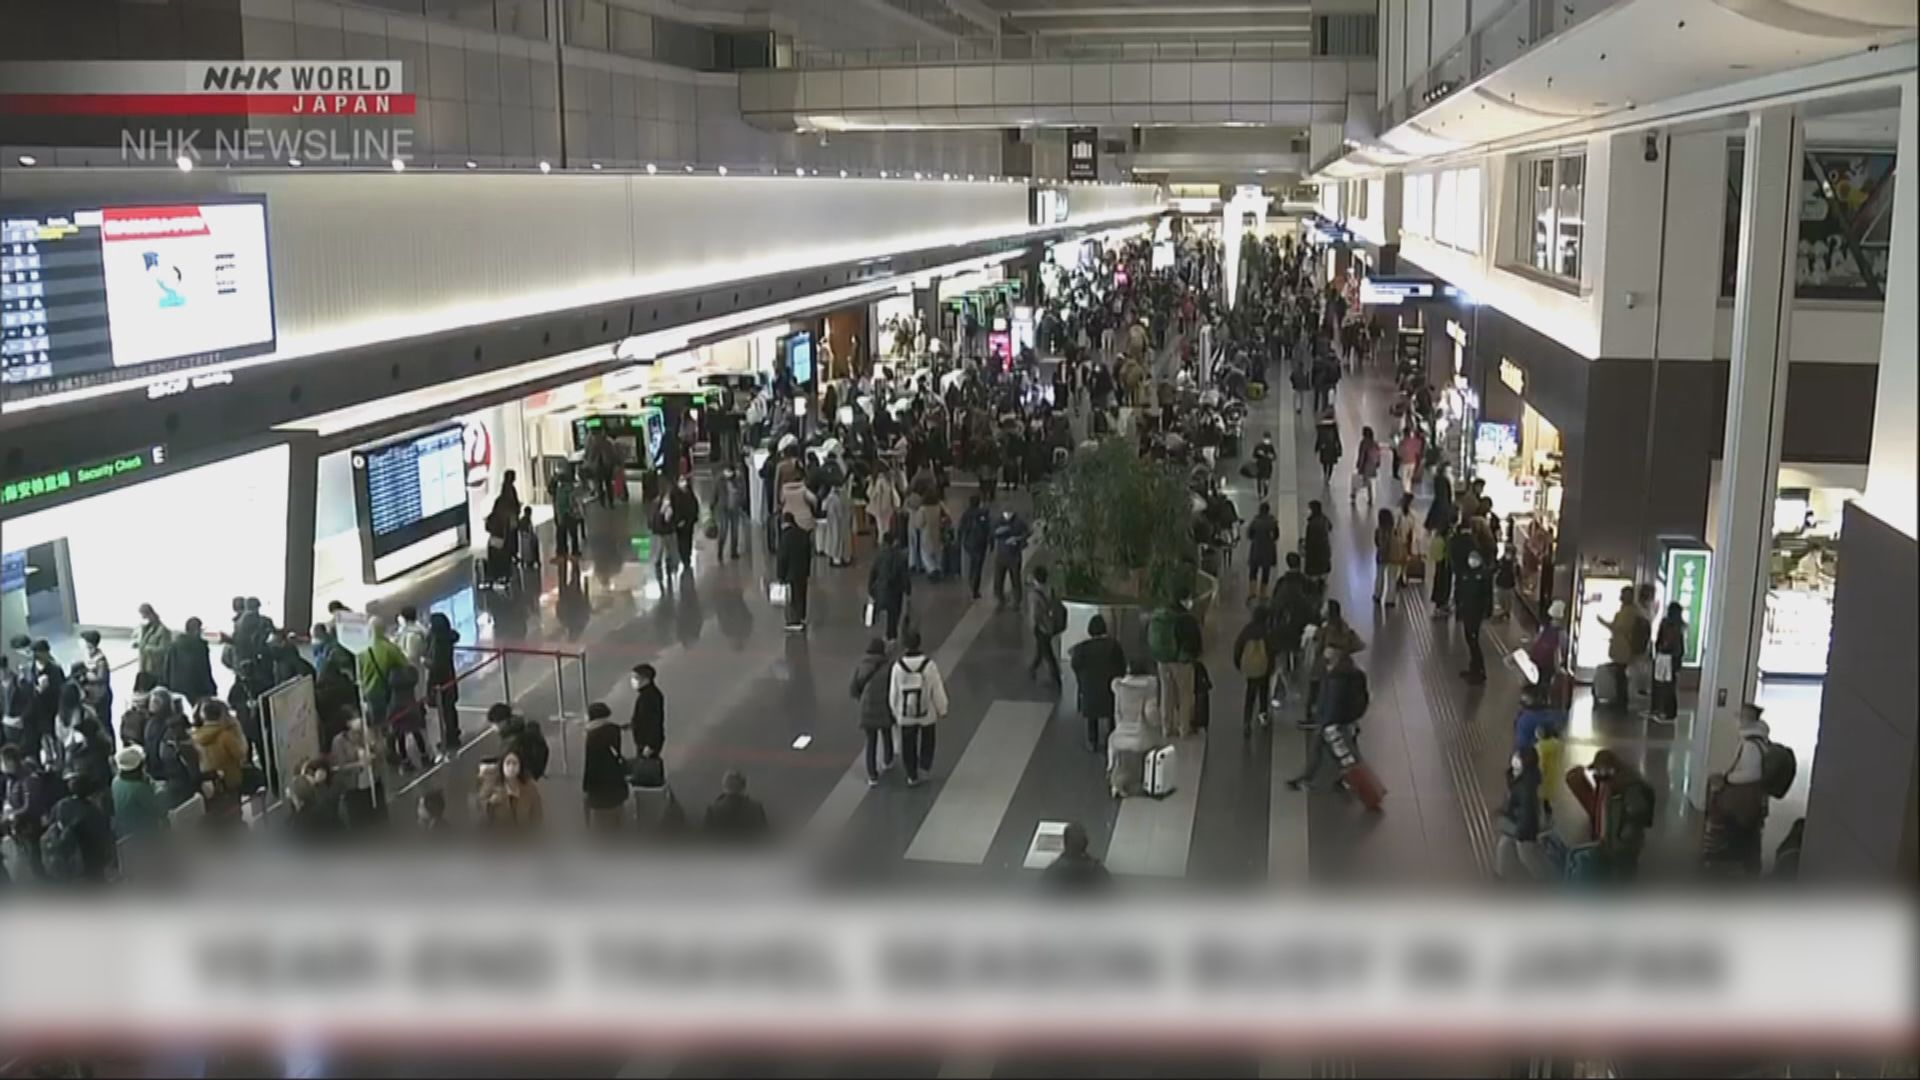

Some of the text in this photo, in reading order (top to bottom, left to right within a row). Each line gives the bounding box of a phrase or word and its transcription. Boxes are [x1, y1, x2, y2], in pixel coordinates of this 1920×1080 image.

[152, 446, 165, 464] E
[77, 456, 142, 483] Security Check
